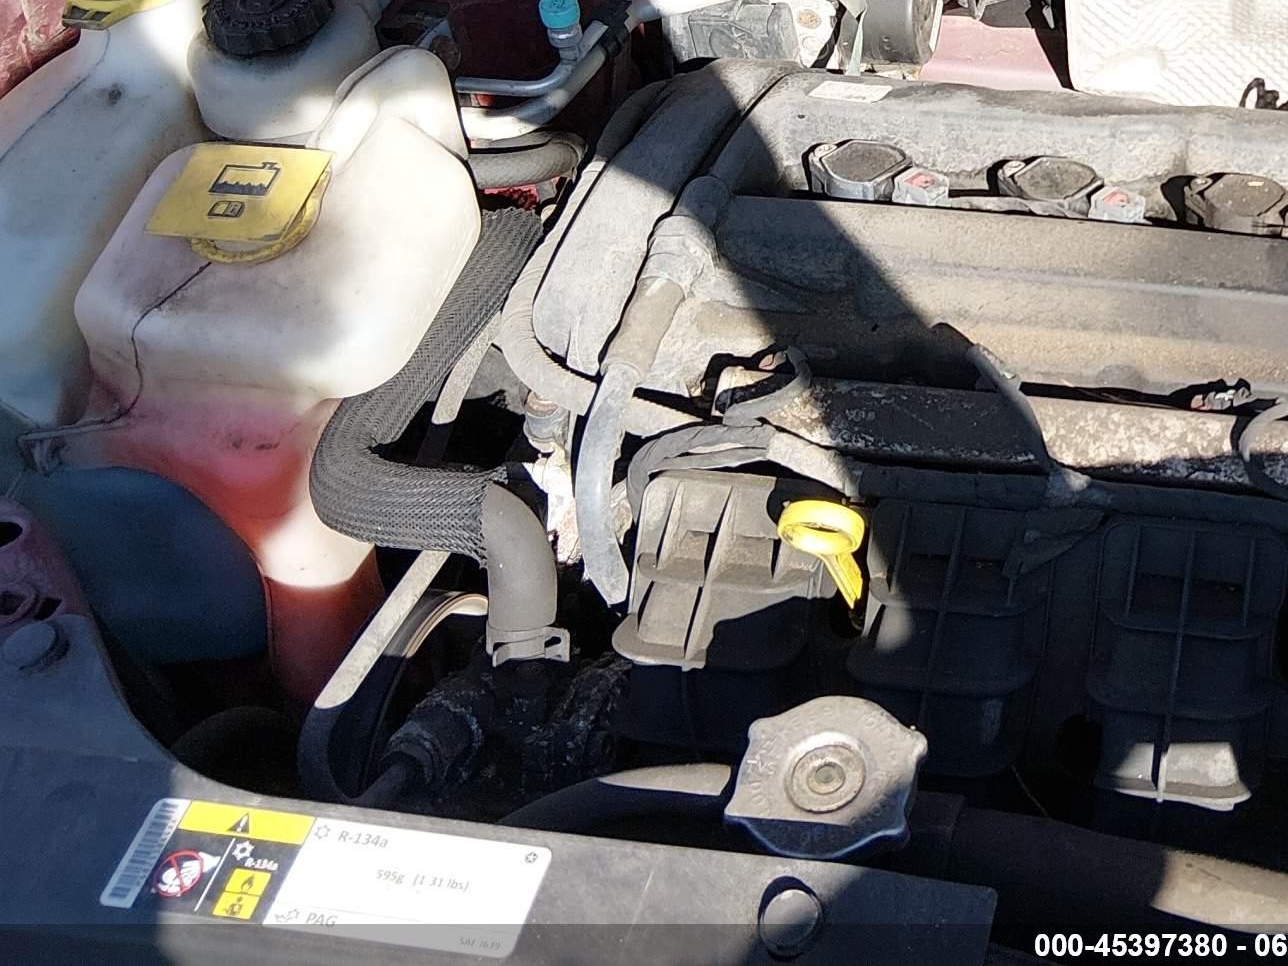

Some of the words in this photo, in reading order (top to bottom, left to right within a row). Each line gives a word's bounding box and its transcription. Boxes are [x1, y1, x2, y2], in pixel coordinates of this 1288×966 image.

[337, 829, 390, 849] R-134a
[375, 868, 405, 885] 595g
[305, 911, 339, 929] PAG
